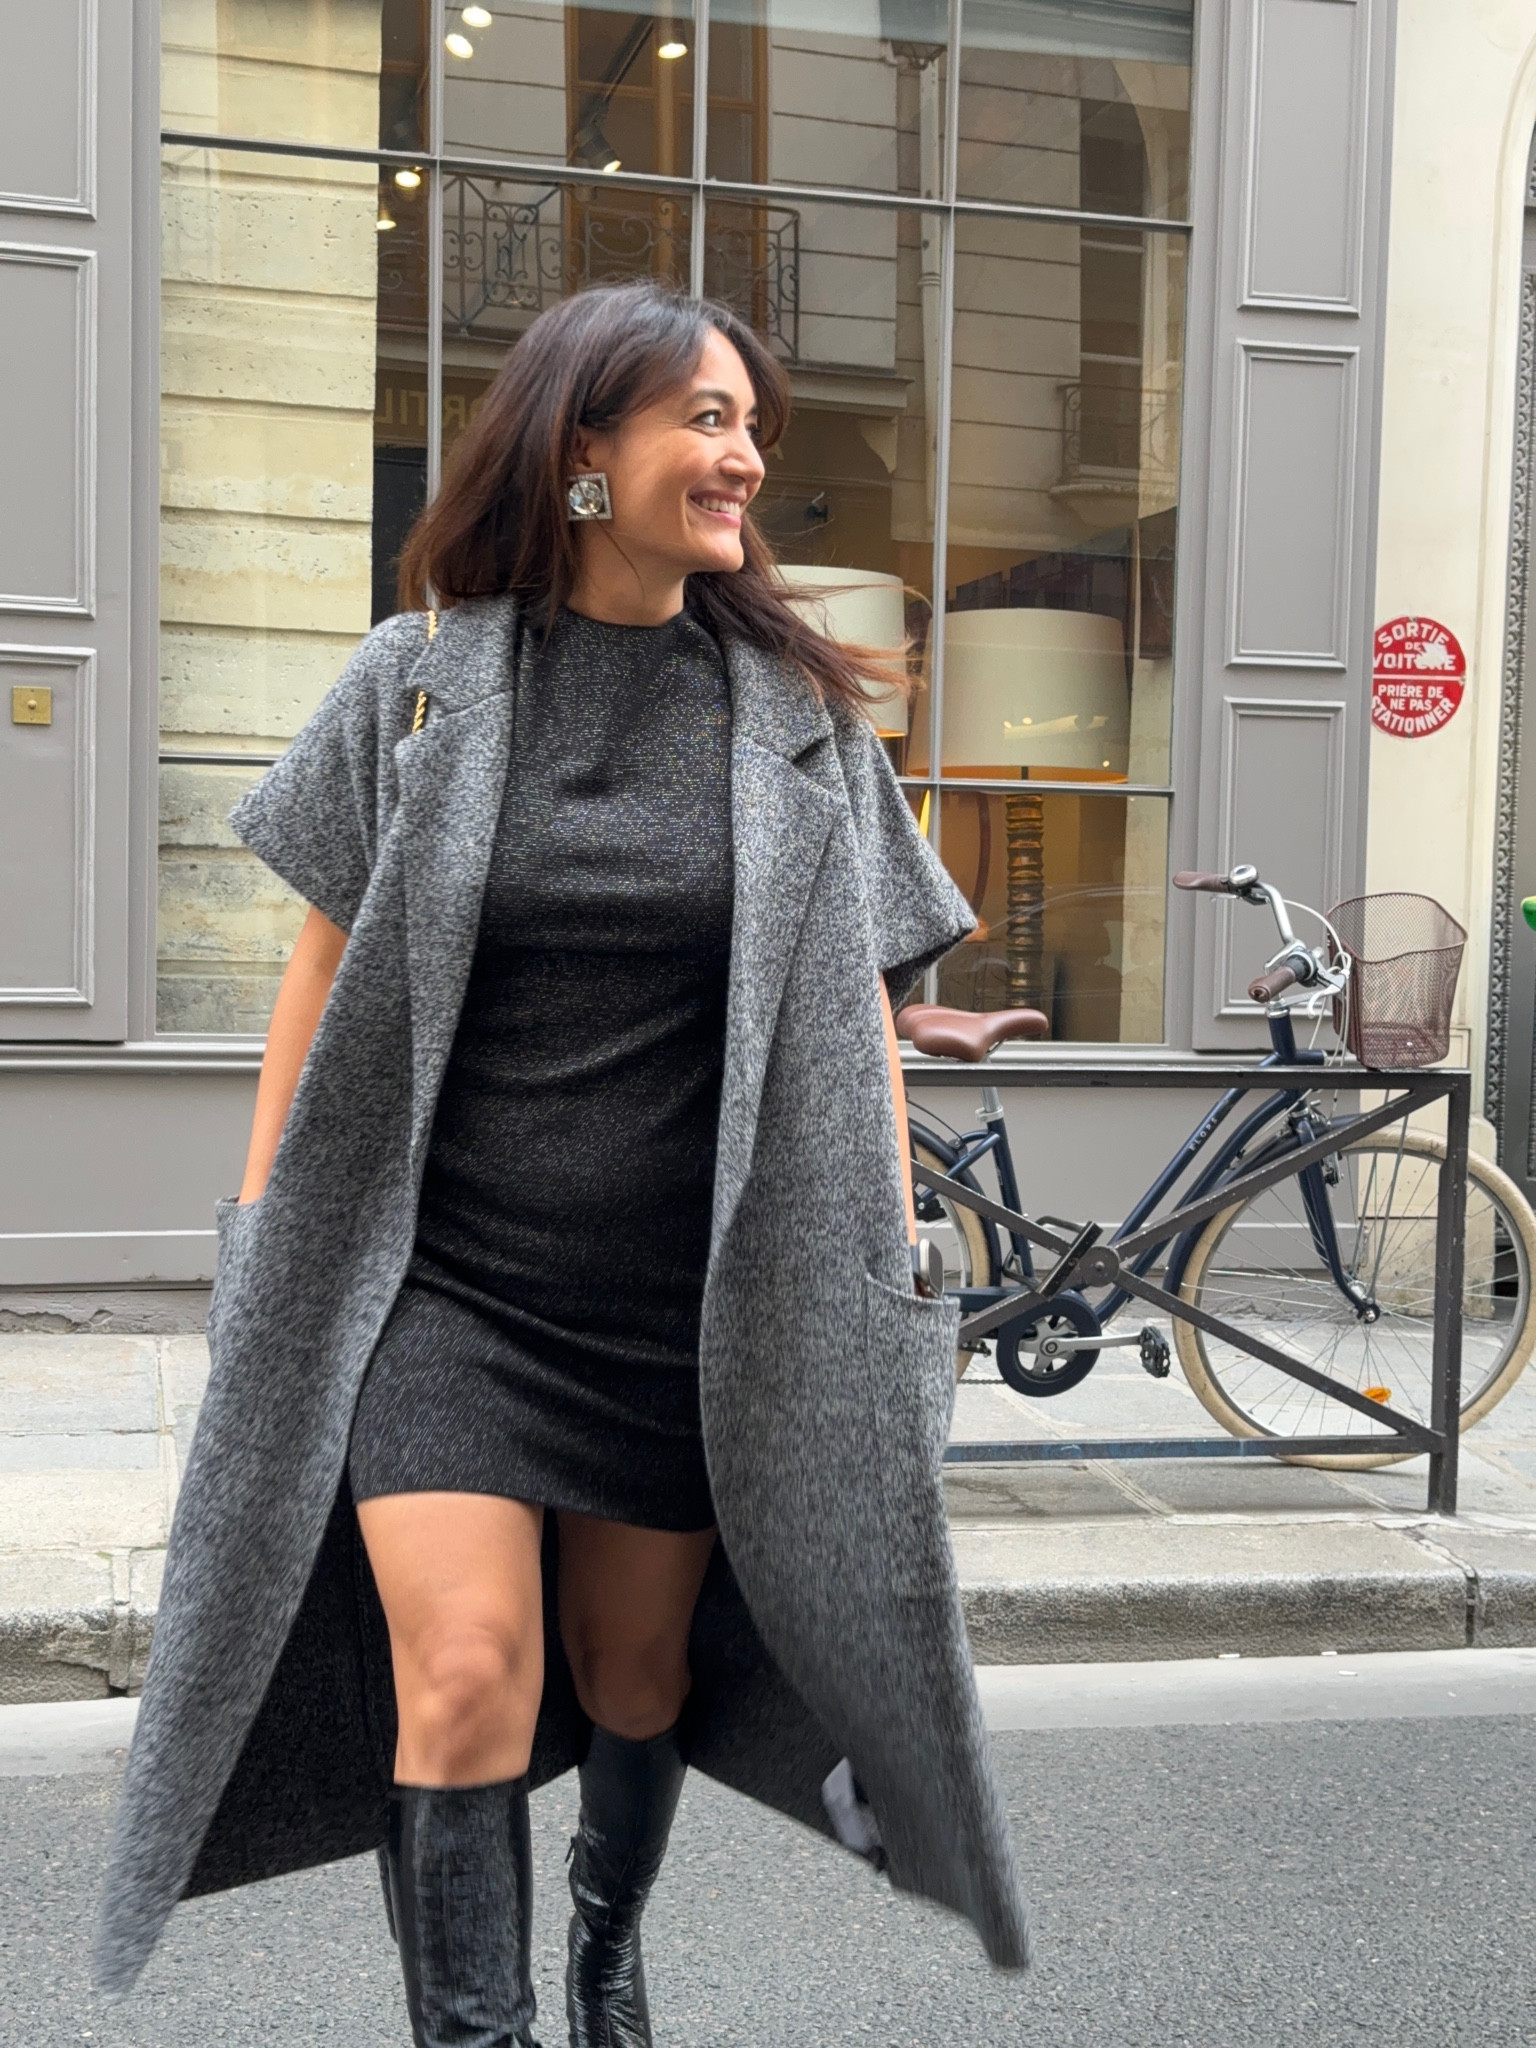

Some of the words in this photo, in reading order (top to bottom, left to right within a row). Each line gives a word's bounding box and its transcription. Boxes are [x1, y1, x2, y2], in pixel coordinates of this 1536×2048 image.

[1378, 622, 1449, 648] SORTIE
[1373, 653, 1456, 671] VOITE
[1427, 686, 1444, 698] DE
[1390, 698, 1406, 710] NE
[1409, 699, 1432, 711] PAS
